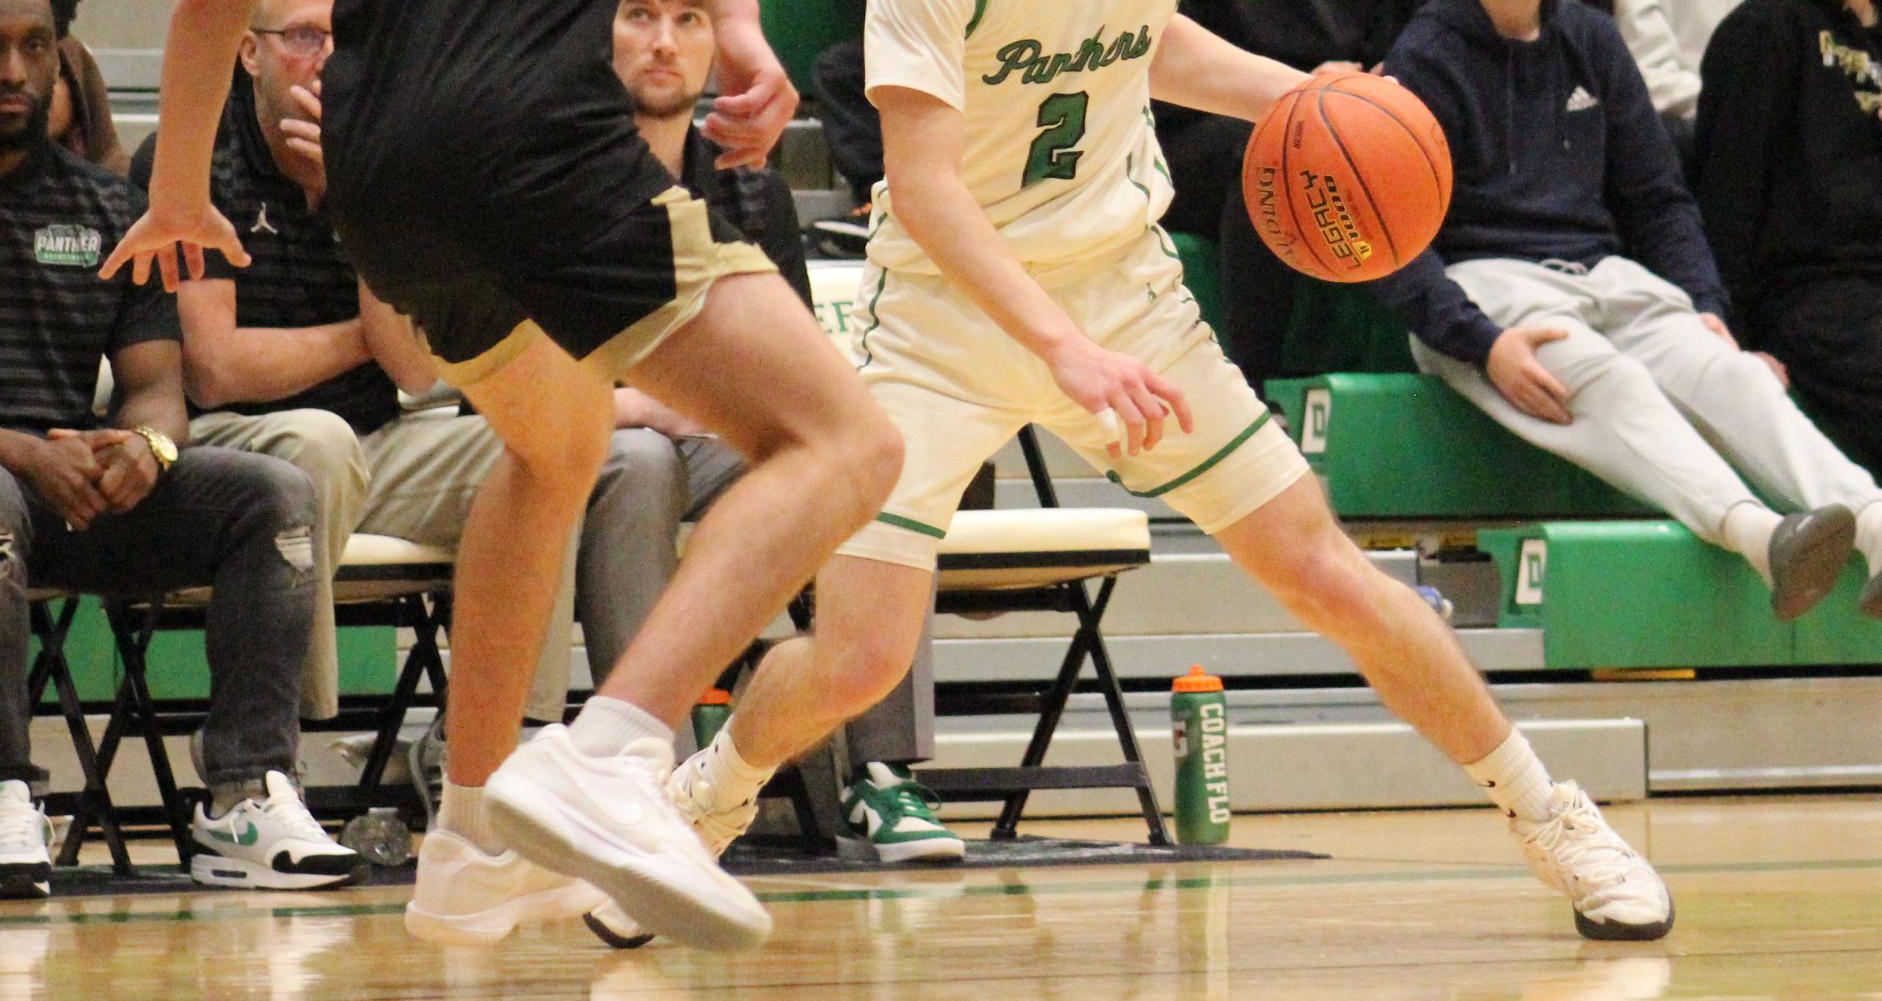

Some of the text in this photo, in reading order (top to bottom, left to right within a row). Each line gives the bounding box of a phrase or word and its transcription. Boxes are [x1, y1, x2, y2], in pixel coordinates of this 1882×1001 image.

[982, 24, 1152, 86] Panthers
[1021, 90, 1090, 190] 2
[1299, 168, 1362, 270] LEGACY
[1200, 702, 1232, 825] COACH FLO
